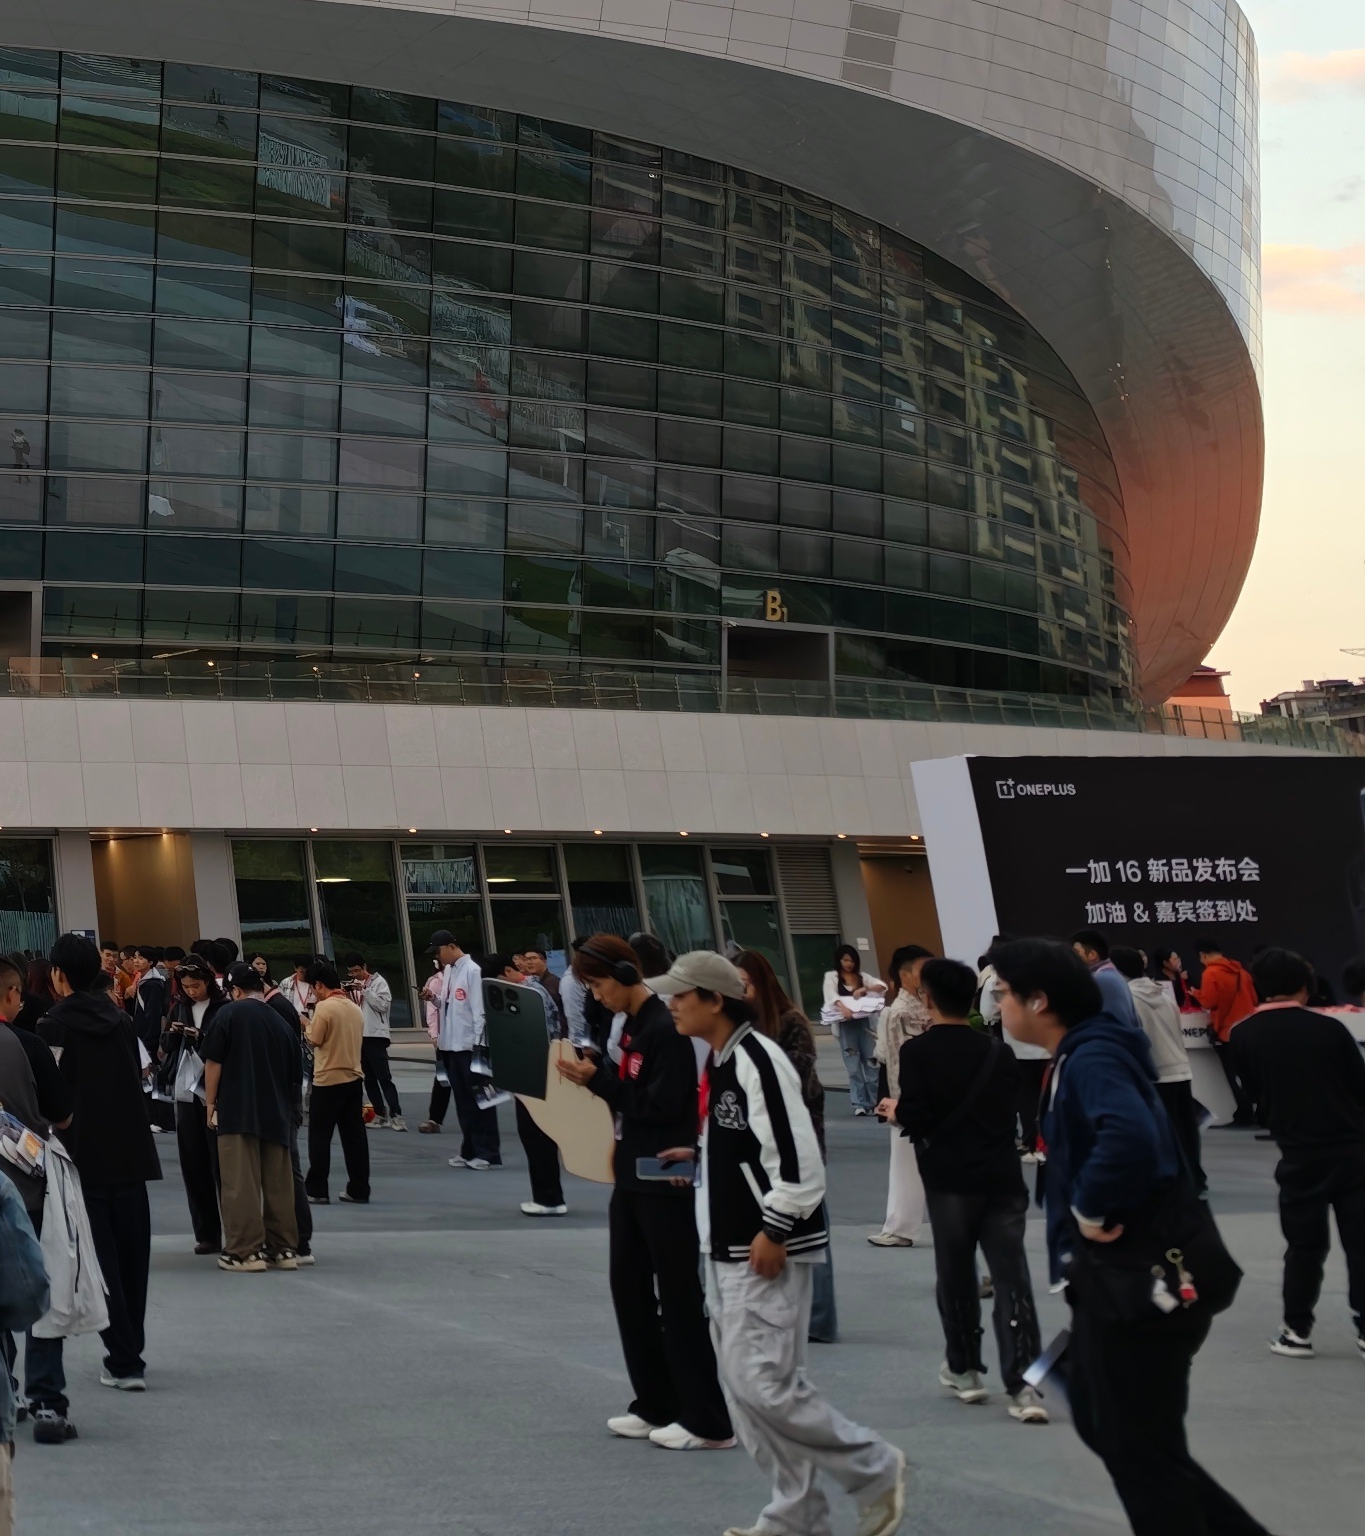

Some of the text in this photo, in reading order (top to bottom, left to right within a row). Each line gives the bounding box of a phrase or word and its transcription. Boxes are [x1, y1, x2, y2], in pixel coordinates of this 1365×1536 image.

[1016, 783, 1076, 796] ONEPLUS
[1065, 857, 1260, 884] 一加 16 新品发布会
[1085, 899, 1258, 924] 加油 & 嘉宾签到处
